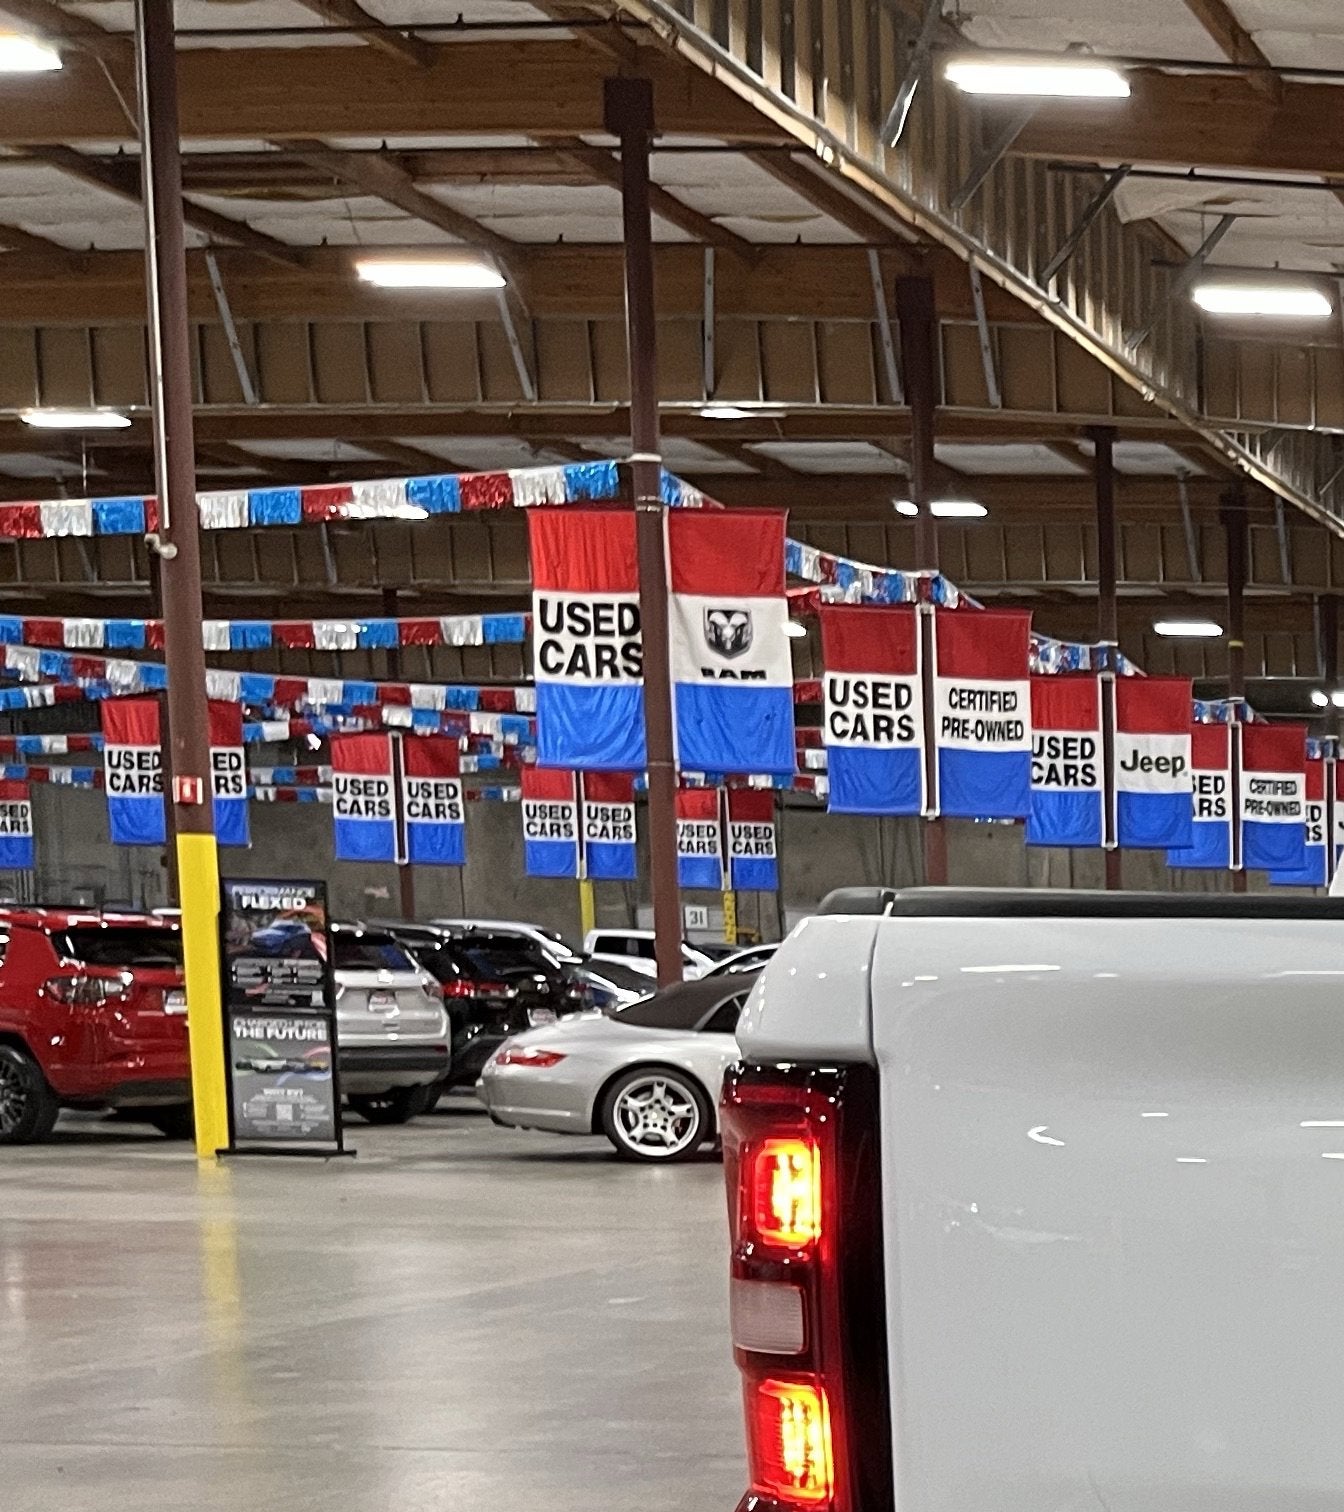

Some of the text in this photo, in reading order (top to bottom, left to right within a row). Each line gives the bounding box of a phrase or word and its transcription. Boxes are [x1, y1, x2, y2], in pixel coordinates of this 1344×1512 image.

[539, 598, 641, 637] USED
[539, 638, 643, 678] CARS
[829, 678, 913, 711] USED
[948, 687, 1018, 712] CERTIFIED
[829, 711, 916, 742] CARS
[941, 716, 1024, 741] PRE-OWNED
[1031, 735, 1096, 760] USED
[107, 750, 162, 771] USED
[212, 752, 242, 771] ED
[1120, 749, 1186, 778] Jeep
[109, 772, 164, 793] CARS
[1031, 761, 1097, 787] CARS
[214, 775, 243, 794] RS
[335, 777, 389, 797] USED
[407, 781, 459, 800] USED
[1192, 775, 1226, 794] ED
[1250, 778, 1298, 796] CERTIFIED
[0, 804, 29, 818] SED
[336, 798, 391, 817] CARS
[407, 801, 461, 819] CARS
[525, 804, 573, 820] USED
[586, 805, 632, 823] USED
[1192, 798, 1227, 817] RS
[1244, 798, 1301, 816] PRE-OWNED
[0, 820, 29, 833] ARS
[526, 821, 574, 838] CARS
[586, 823, 633, 840] CARS
[731, 824, 773, 840] USED
[678, 840, 718, 854] CARS
[732, 841, 774, 855] CARS
[241, 895, 307, 910] FLEXED
[235, 1027, 327, 1041] THE FUTURE
